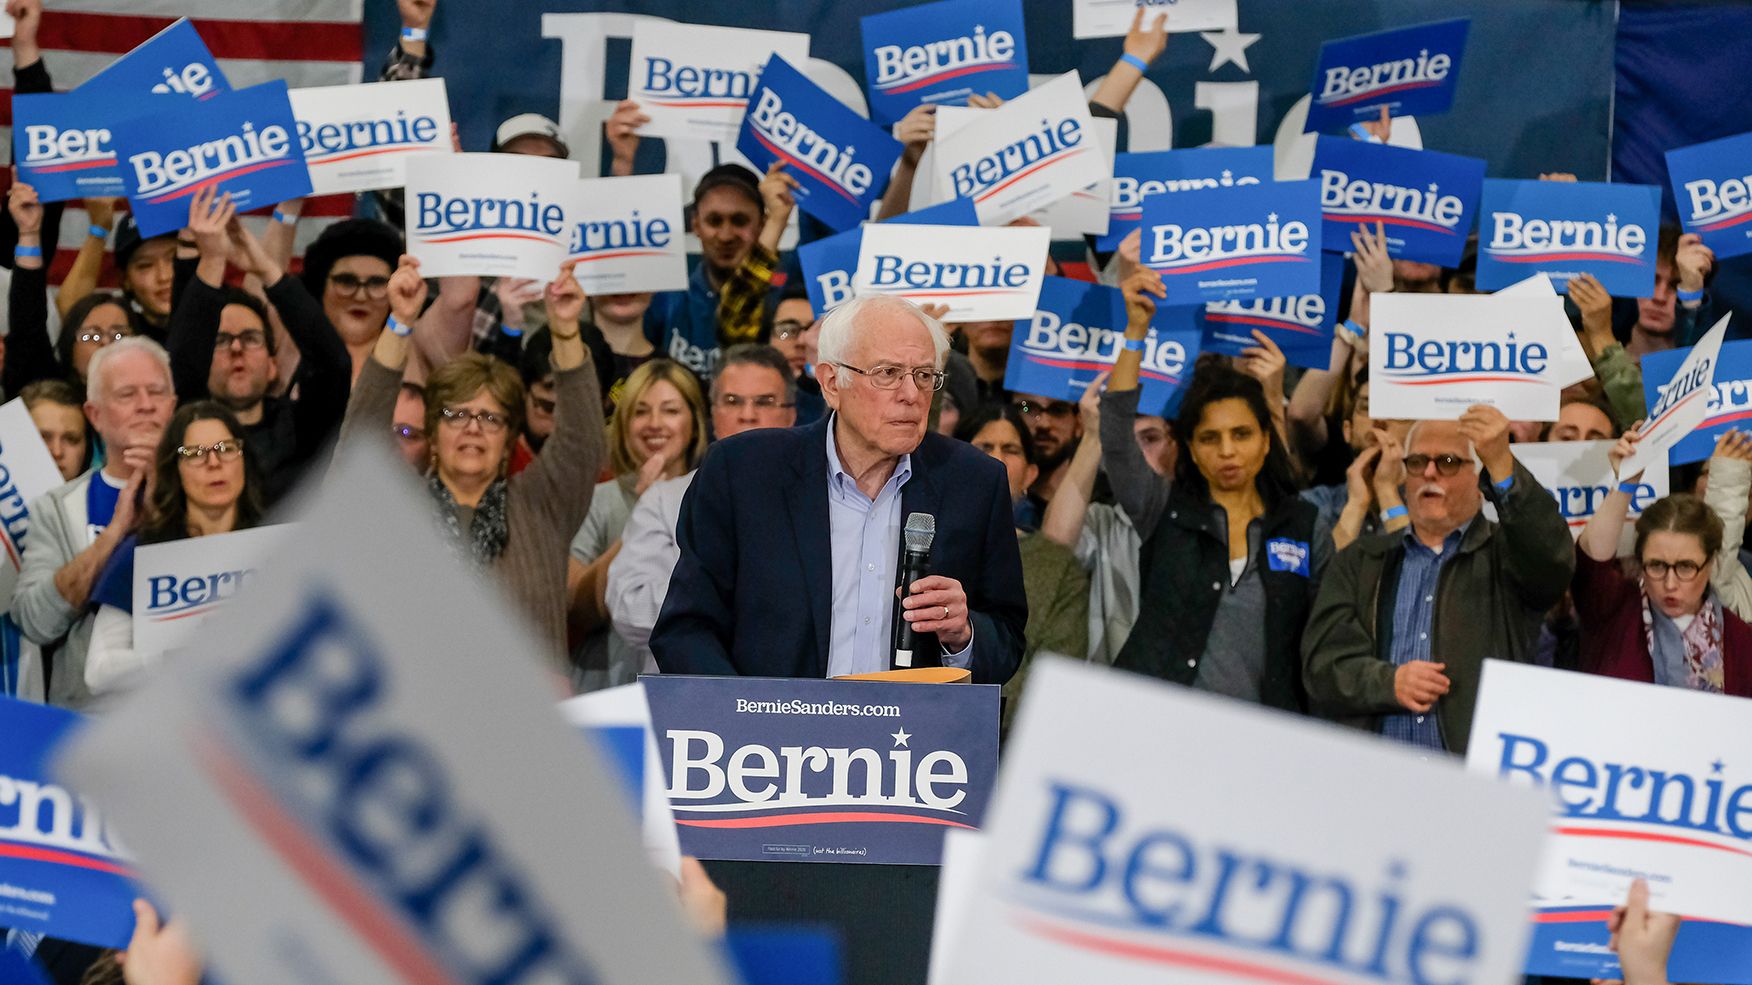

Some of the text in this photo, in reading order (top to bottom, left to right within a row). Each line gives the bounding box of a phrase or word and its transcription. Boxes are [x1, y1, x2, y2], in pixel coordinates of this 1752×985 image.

[643, 56, 764, 98] Bern
[873, 24, 1015, 84] Bernie
[1320, 48, 1451, 99] Bernie
[25, 125, 117, 160] Ber
[129, 120, 290, 193] Bernie
[750, 87, 873, 196] Bernie
[950, 116, 1083, 197] Bernie
[416, 191, 564, 235] Bernie
[1321, 169, 1463, 228] Bernie
[569, 210, 670, 254] rnie
[1149, 212, 1309, 263] Bernie
[1489, 212, 1646, 257] Bernie
[870, 255, 1030, 287] Bernie
[1383, 331, 1548, 375] Bernie
[736, 699, 901, 717] BernieSanders.com
[666, 726, 968, 808] Bernie
[1021, 776, 1480, 985] Bernie
